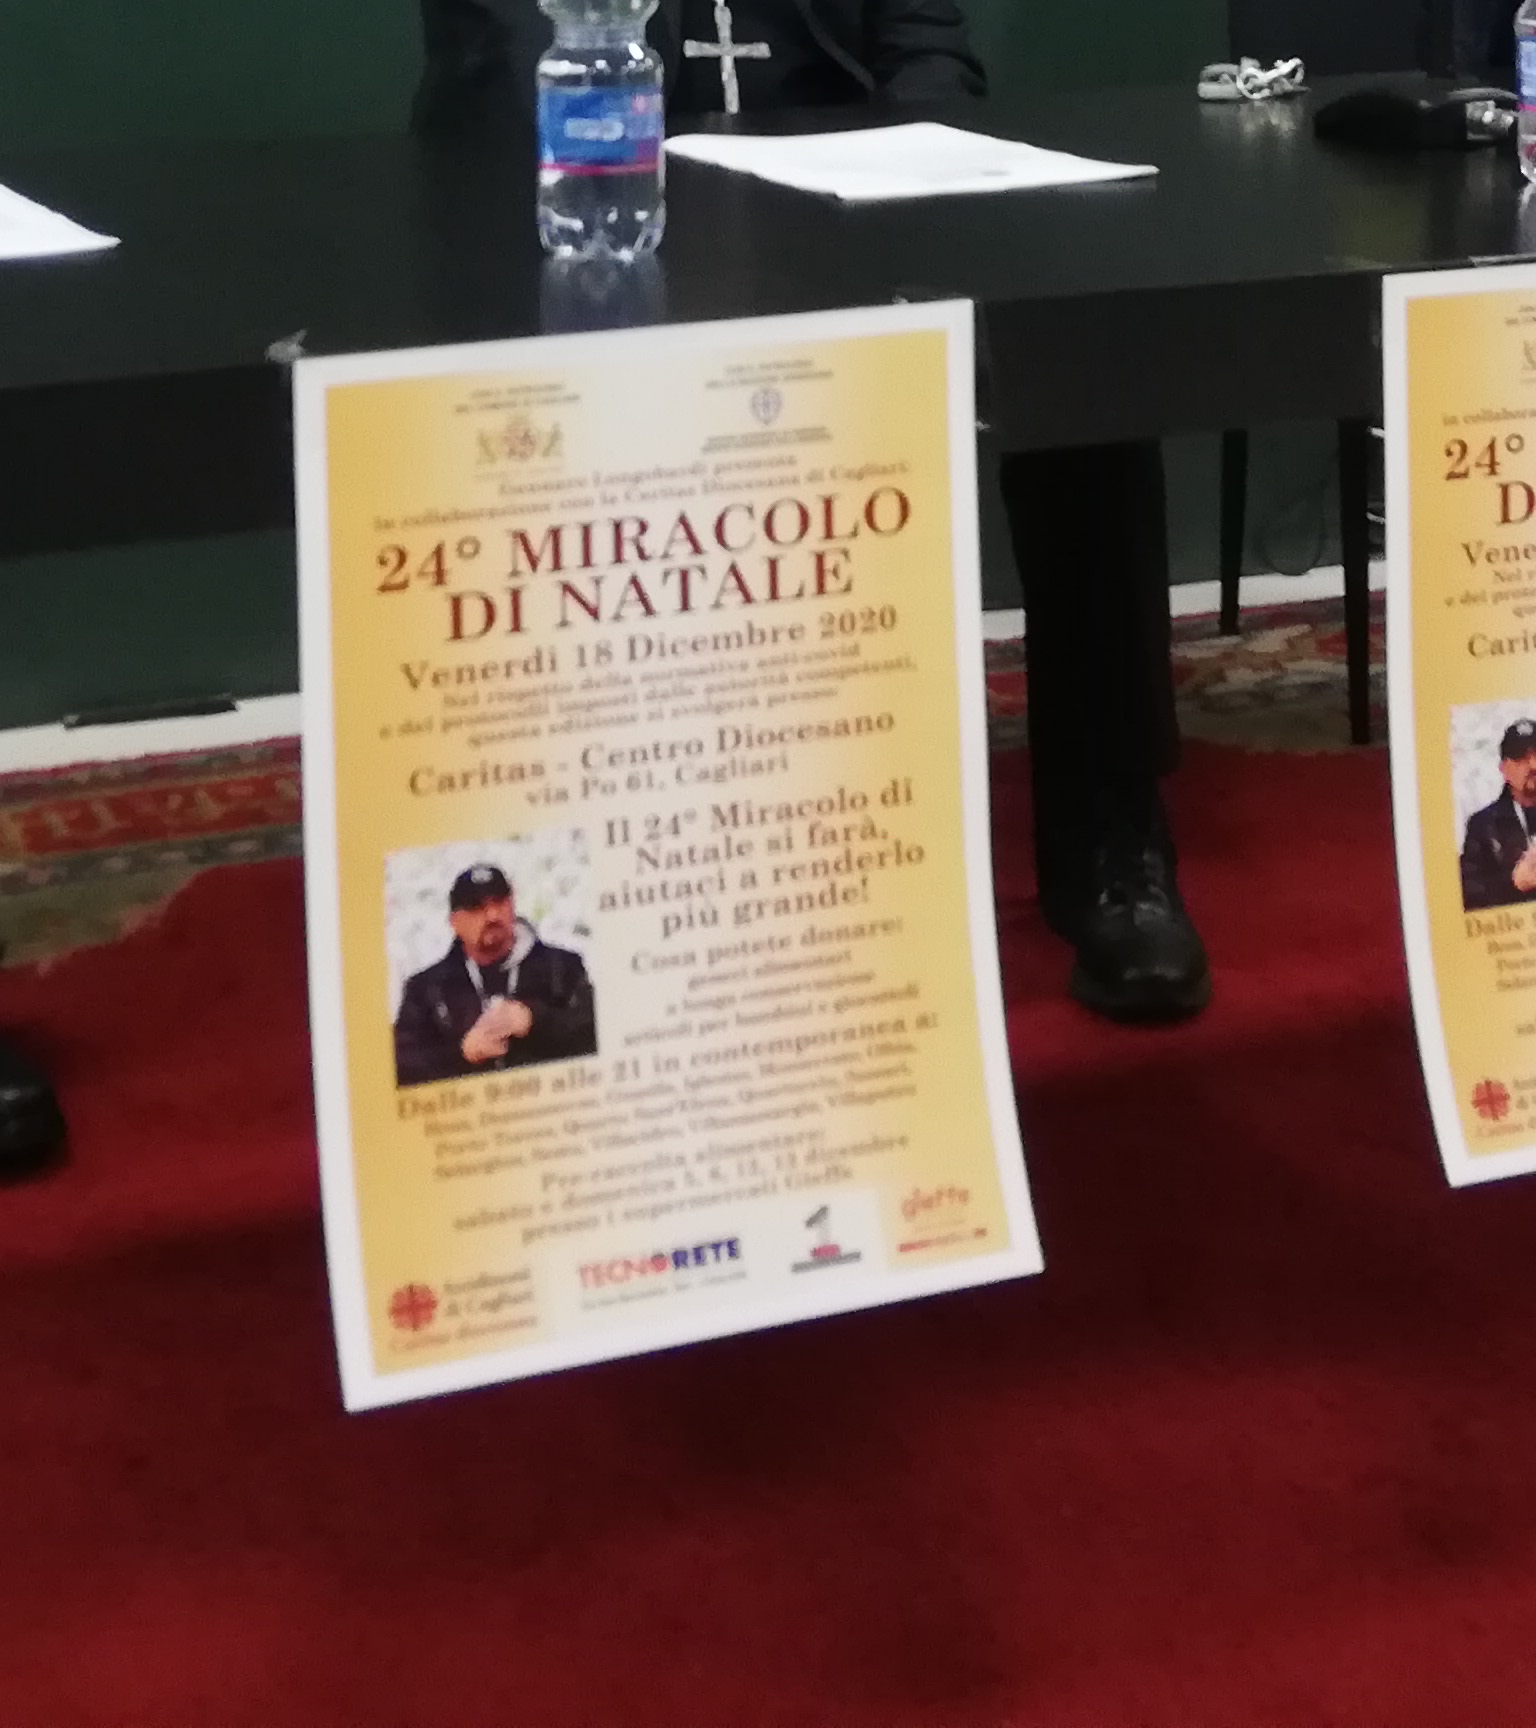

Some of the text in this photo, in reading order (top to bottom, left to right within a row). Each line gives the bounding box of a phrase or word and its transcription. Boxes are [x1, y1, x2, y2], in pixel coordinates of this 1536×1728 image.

[1444, 432, 1524, 481] 24°
[375, 535, 483, 595] 24°
[504, 485, 912, 580] MIRACOLO
[445, 546, 855, 643] DI NATALE
[577, 637, 615, 670] 18
[627, 617, 806, 663] Dicembre
[819, 603, 898, 639] 2020
[408, 758, 547, 798] Caritas
[581, 737, 705, 771] Centro
[716, 712, 894, 754] Diocesano
[581, 774, 618, 801] Po
[674, 750, 790, 785] Cagliari
[644, 806, 698, 843] 24°
[710, 784, 869, 832] Miracolo
[879, 775, 913, 808] di
[598, 837, 926, 913] aiutaci a renderlo
[635, 832, 755, 876] Natale
[766, 825, 794, 853] si
[661, 874, 870, 941] più grande!
[707, 933, 794, 966] potete
